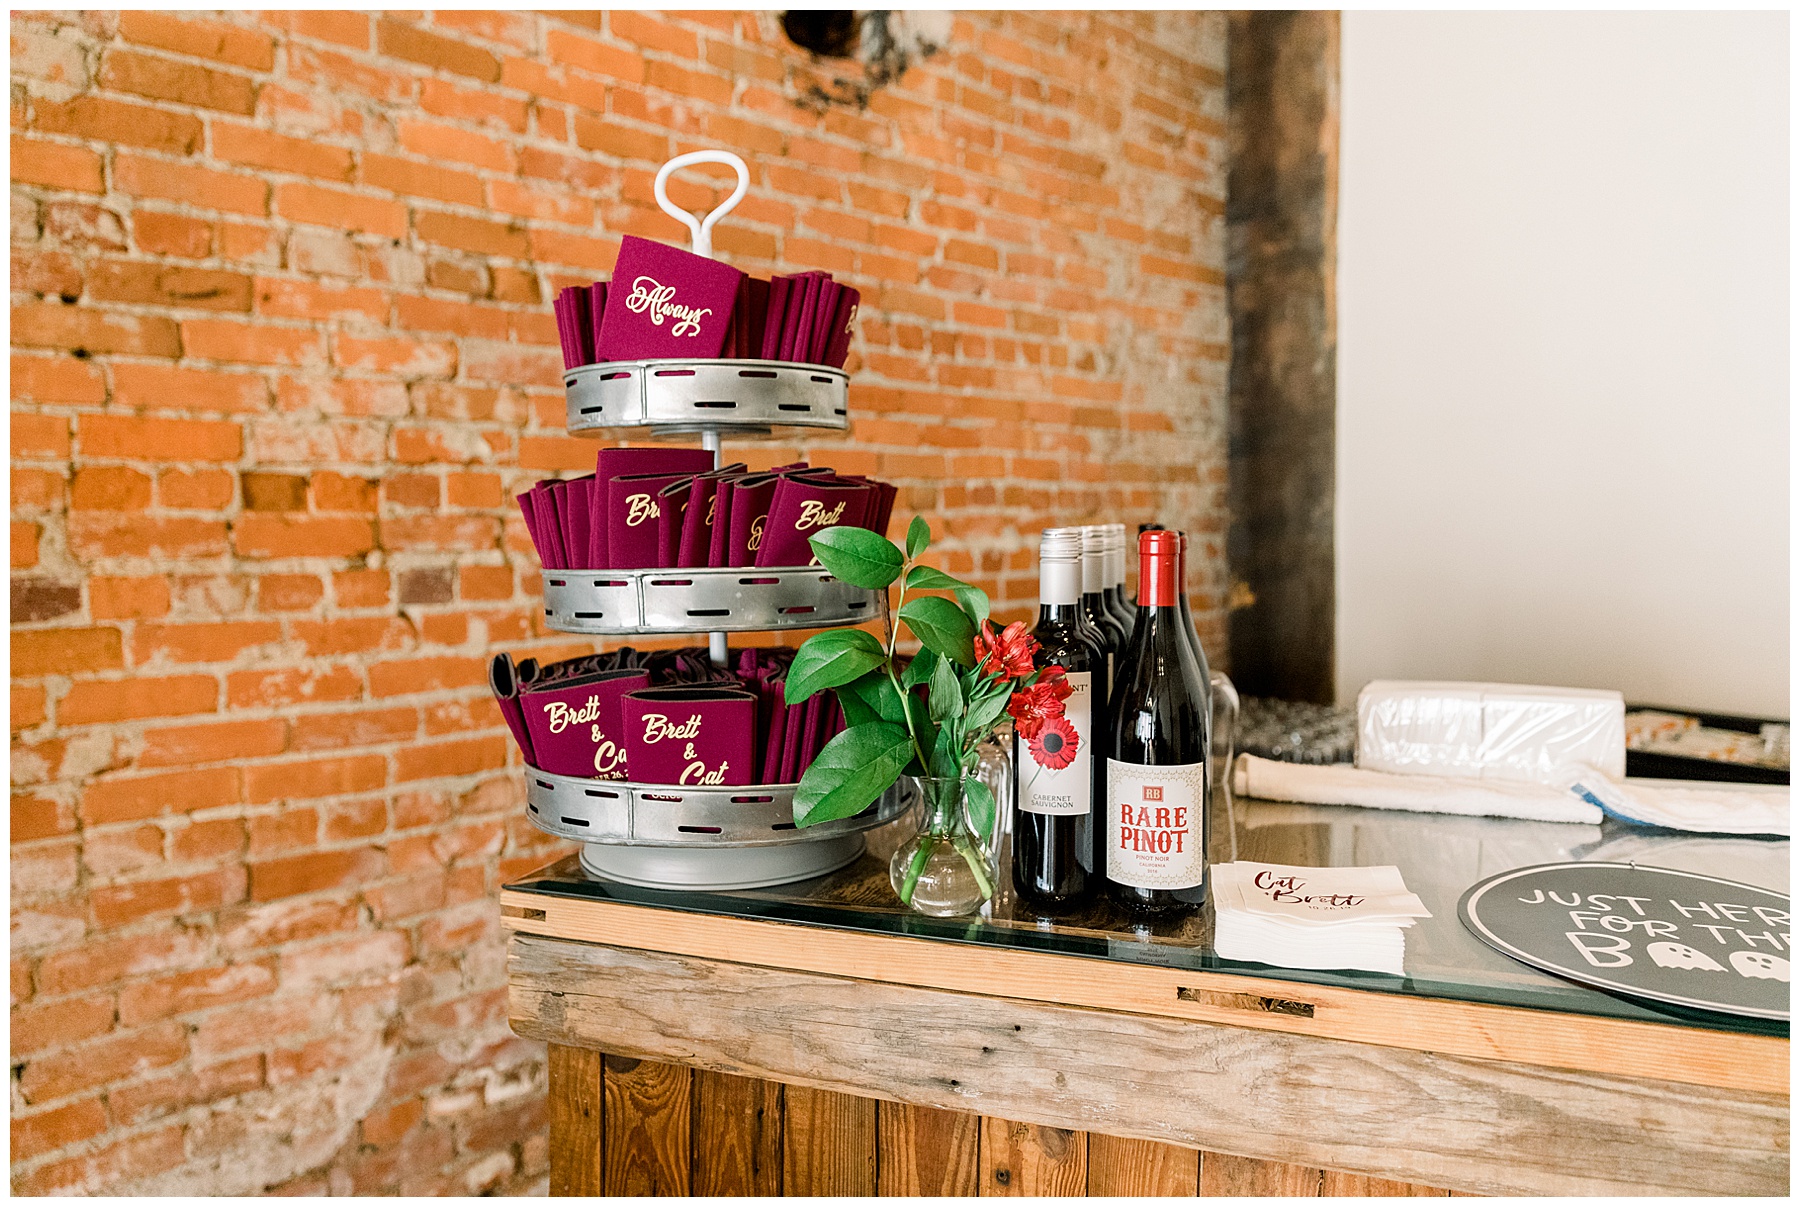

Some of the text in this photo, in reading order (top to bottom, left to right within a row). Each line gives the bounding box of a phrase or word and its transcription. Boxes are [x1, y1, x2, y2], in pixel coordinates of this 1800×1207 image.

[625, 275, 712, 337] Always
[625, 493, 660, 527] Br
[795, 500, 847, 530] Brett
[543, 695, 600, 734] Brett
[591, 723, 605, 743] &
[641, 713, 702, 744] Brett
[594, 740, 628, 773] Ca
[683, 742, 698, 760] &
[679, 760, 729, 785] Cat
[1031, 800, 1074, 808] SAUVIGNON
[1033, 793, 1071, 802] CABERNET
[1145, 788, 1161, 799] RB
[1120, 803, 1188, 828] RARE
[1120, 826, 1189, 853] PINOT
[1254, 870, 1308, 891] Cat
[1272, 889, 1366, 906] Brett
[1518, 889, 1791, 927] JUST HER
[1569, 911, 1680, 939] FOR
